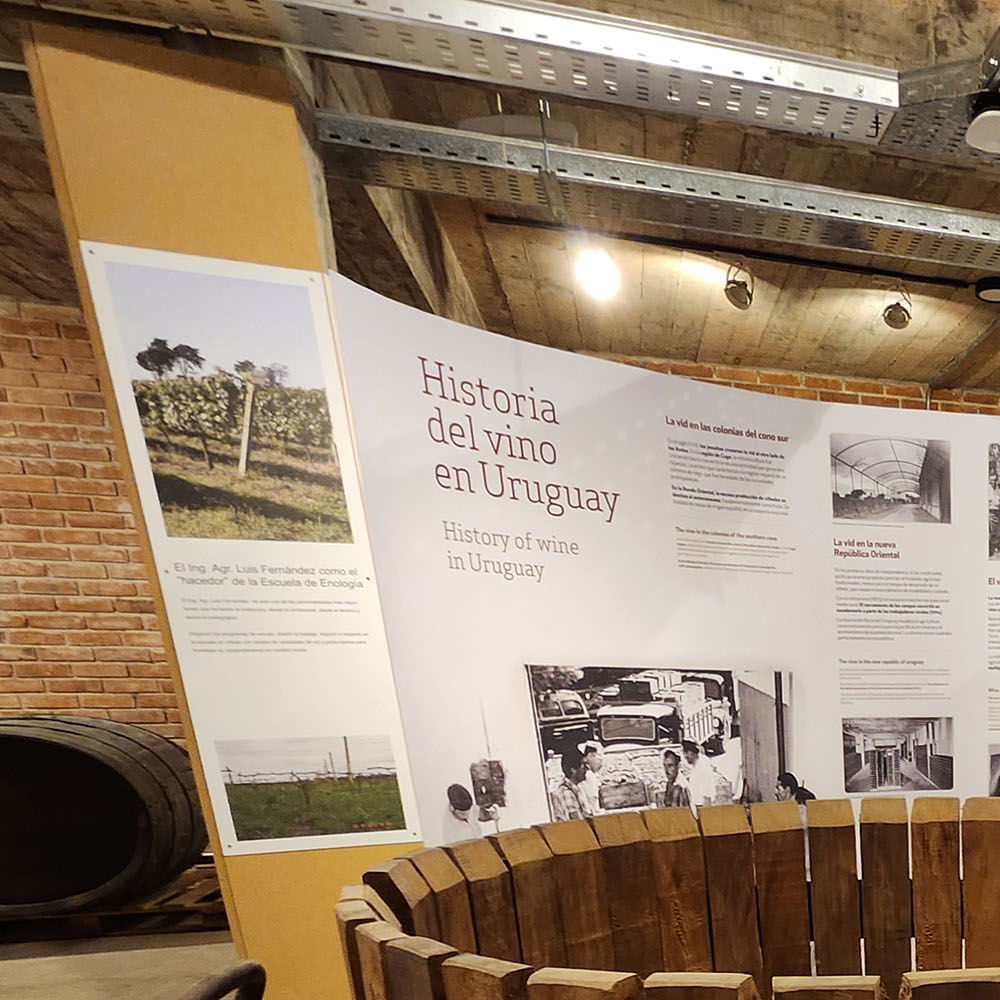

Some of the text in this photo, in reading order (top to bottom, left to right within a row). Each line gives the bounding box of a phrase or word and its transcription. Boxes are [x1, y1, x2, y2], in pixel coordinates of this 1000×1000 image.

[418, 356, 560, 425] Historia
[428, 407, 557, 465] del vino
[666, 416, 675, 426] La
[676, 419, 688, 428] vid
[700, 422, 712, 432] las
[713, 425, 744, 437] colonias
[745, 429, 757, 440] del
[758, 432, 776, 442] cono
[777, 435, 789, 443] sur
[435, 462, 475, 494] en
[478, 461, 620, 523] Uruguay
[442, 520, 580, 555] History of wine
[834, 538, 842, 546] La
[844, 539, 854, 547] vid
[866, 540, 874, 548] la
[448, 550, 544, 583] in Uruguay
[834, 548, 900, 560] República Oriental
[174, 562, 186, 572] El
[236, 564, 259, 574] Luis
[261, 564, 316, 576] Fernández
[318, 568, 346, 576] como
[348, 566, 358, 576] el
[988, 578, 996, 586] El
[232, 577, 245, 586] de
[247, 577, 258, 586] la
[260, 578, 302, 587] Escuela
[304, 578, 318, 588] de
[320, 578, 364, 590] Enología
